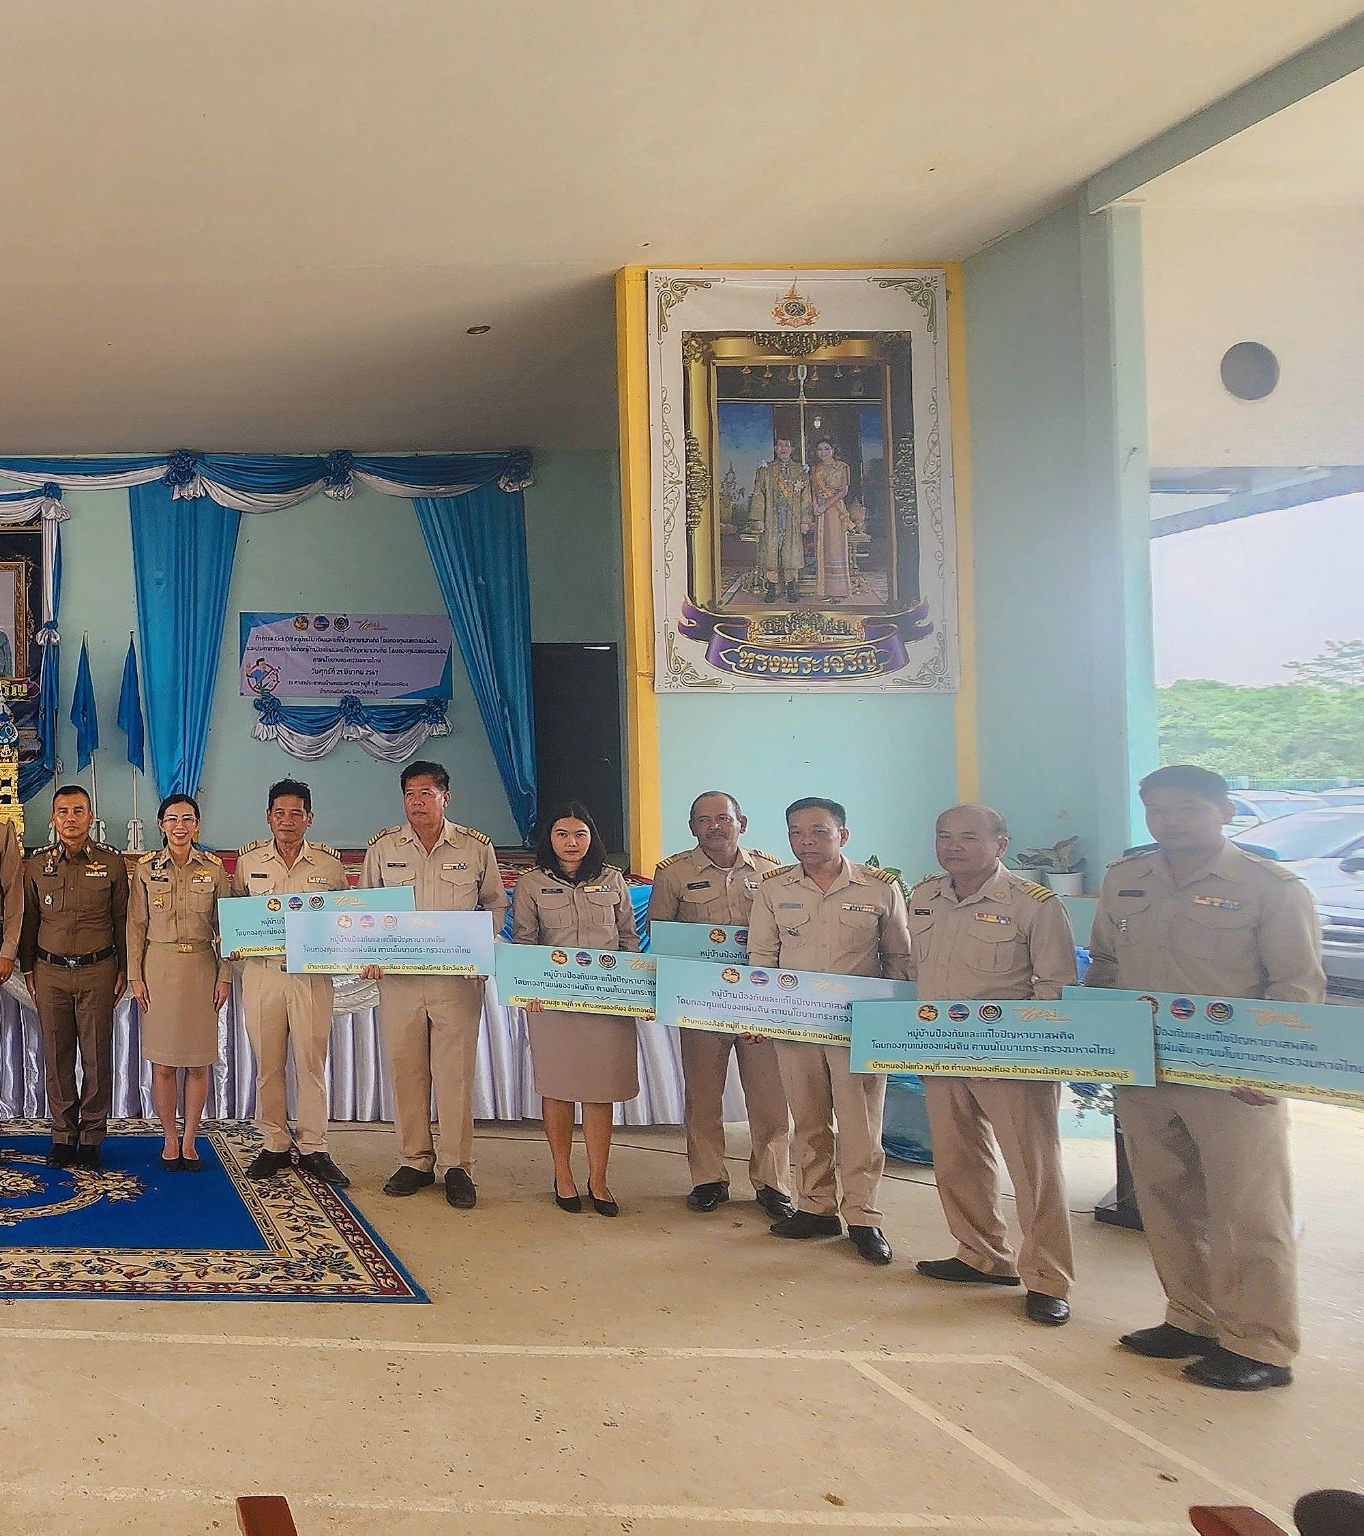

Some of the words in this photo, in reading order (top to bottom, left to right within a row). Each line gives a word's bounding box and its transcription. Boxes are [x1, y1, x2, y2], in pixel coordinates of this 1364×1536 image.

[739, 650, 878, 674] ทรงพระเจริญ
[676, 995, 770, 1014] โดยกองทุนแม่ของแผ่นดิน
[907, 1027, 1075, 1040] หมู่บ้านป้องกันและแก้ไขปัญหายาเสพติด
[871, 1039, 969, 1051] โดยกองทุนแม่ของแผ่นดิน
[971, 1041, 1116, 1055] ตามนโยบายกระทรวงมหาดไทย
[872, 1060, 924, 1070] บ้านหนองไผ่แก้ว
[924, 1061, 940, 1073] หมู่ที่
[951, 1063, 1010, 1074] ตำบลหนองเหียง
[1011, 1065, 1073, 1076] อำเภอพนัสนิคม
[1075, 1068, 1129, 1080] จังหวัดชลบุรี
